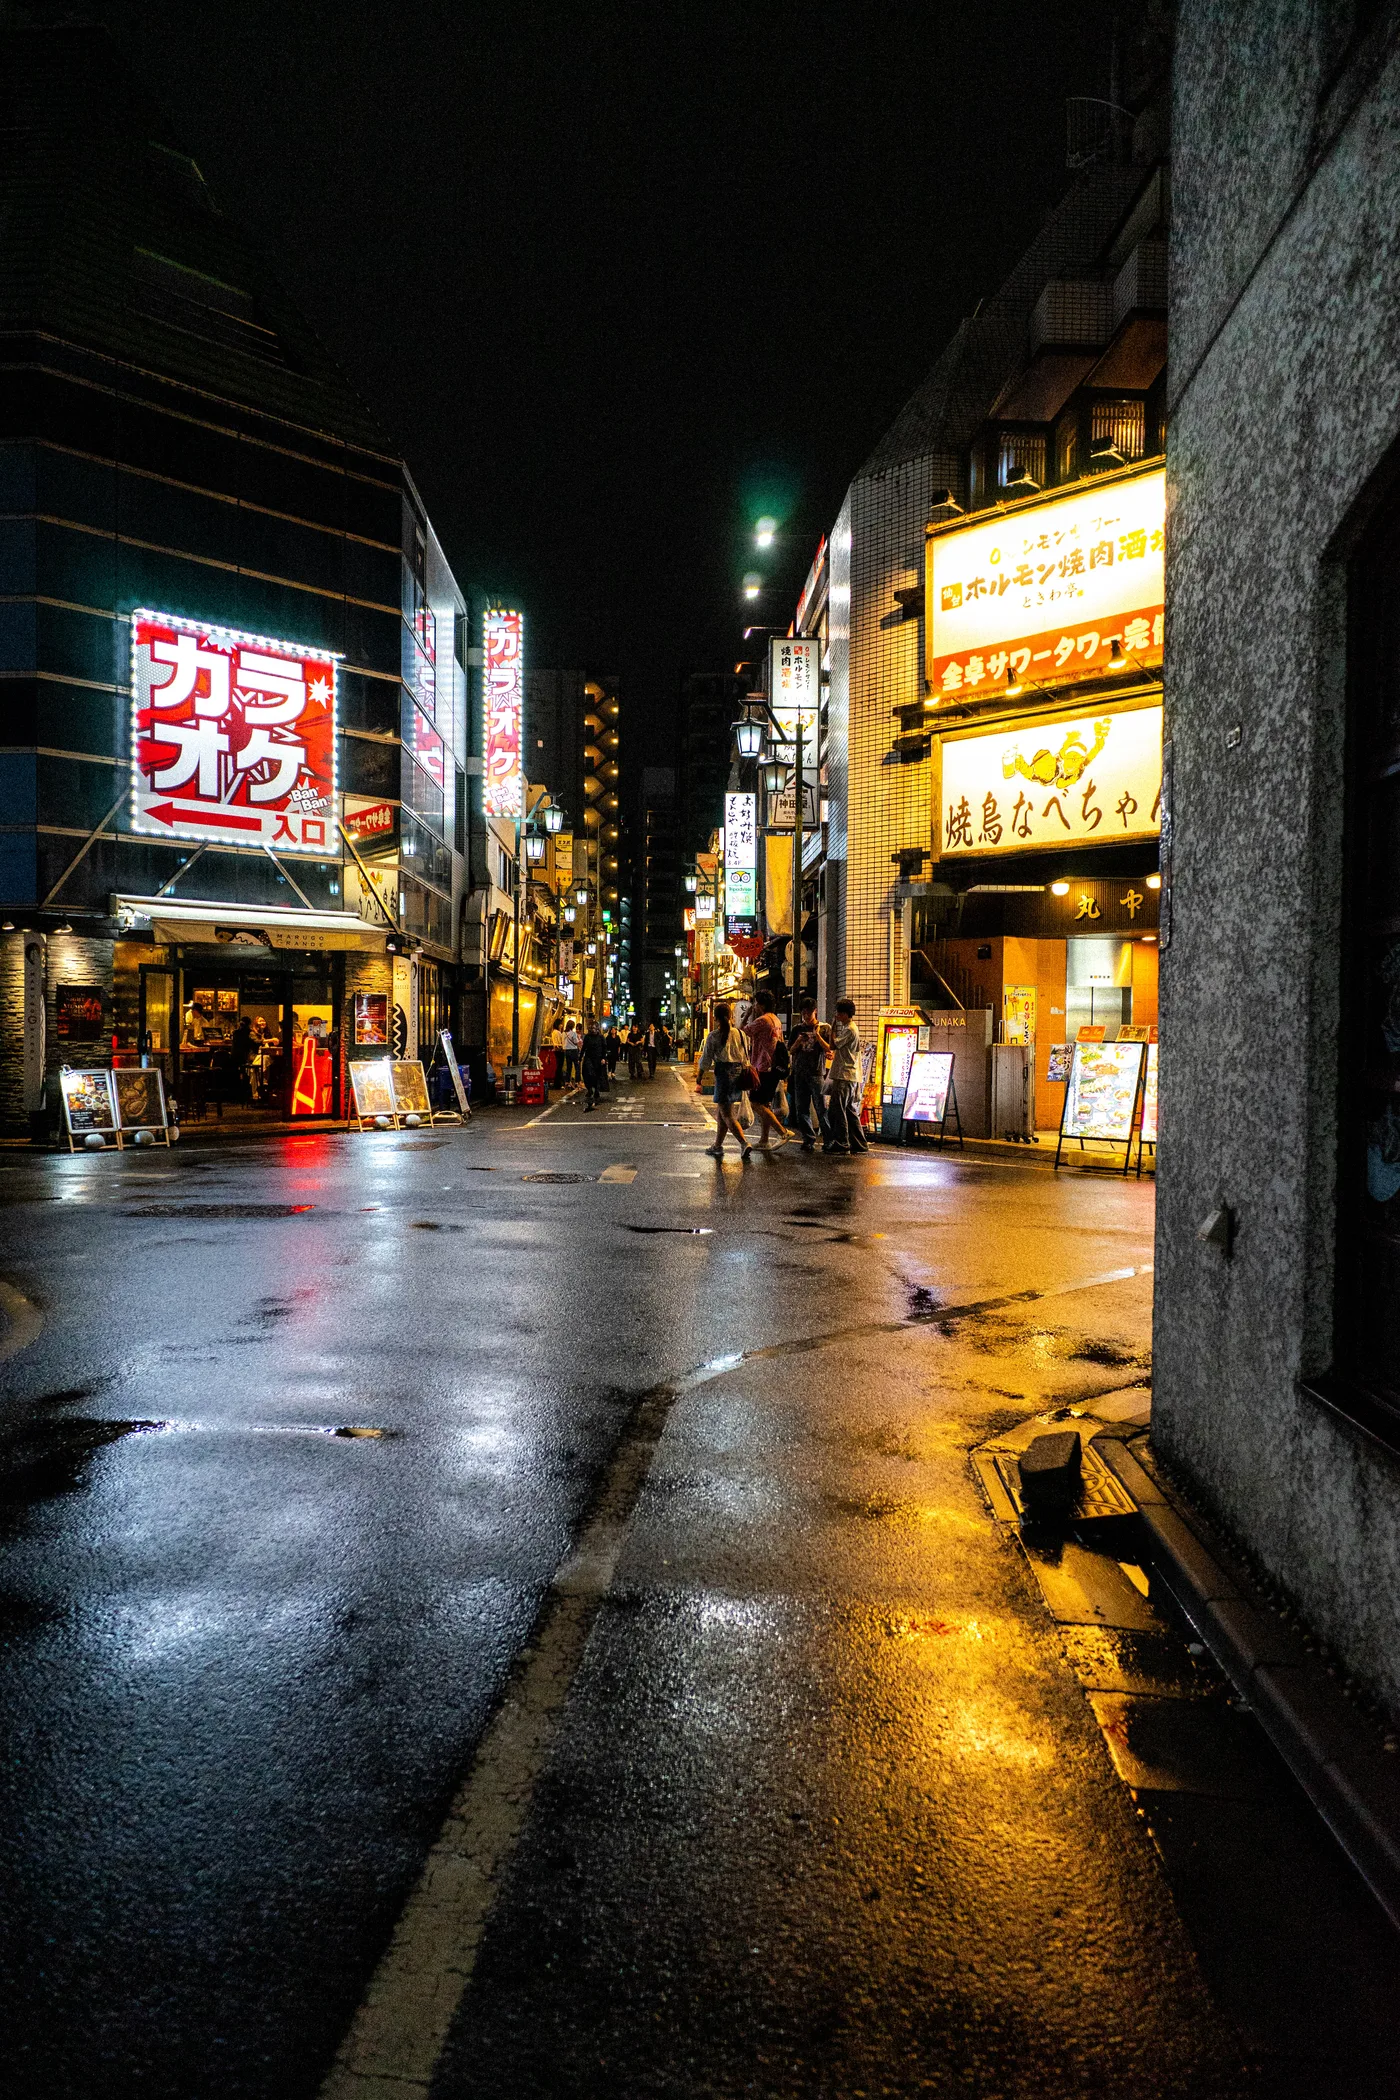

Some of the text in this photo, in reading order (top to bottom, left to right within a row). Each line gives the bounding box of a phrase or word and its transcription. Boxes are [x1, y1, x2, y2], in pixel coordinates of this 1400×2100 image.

[1022, 582, 1078, 609] ときわ亭
[152, 633, 307, 726] カラ
[488, 627, 518, 776] カラオケ
[152, 718, 307, 803] オケ
[291, 786, 318, 802] Ban
[300, 797, 329, 812] Ban
[271, 814, 326, 847] 入口
[276, 933, 324, 941] MARUGO
[276, 938, 324, 948] GRANDE
